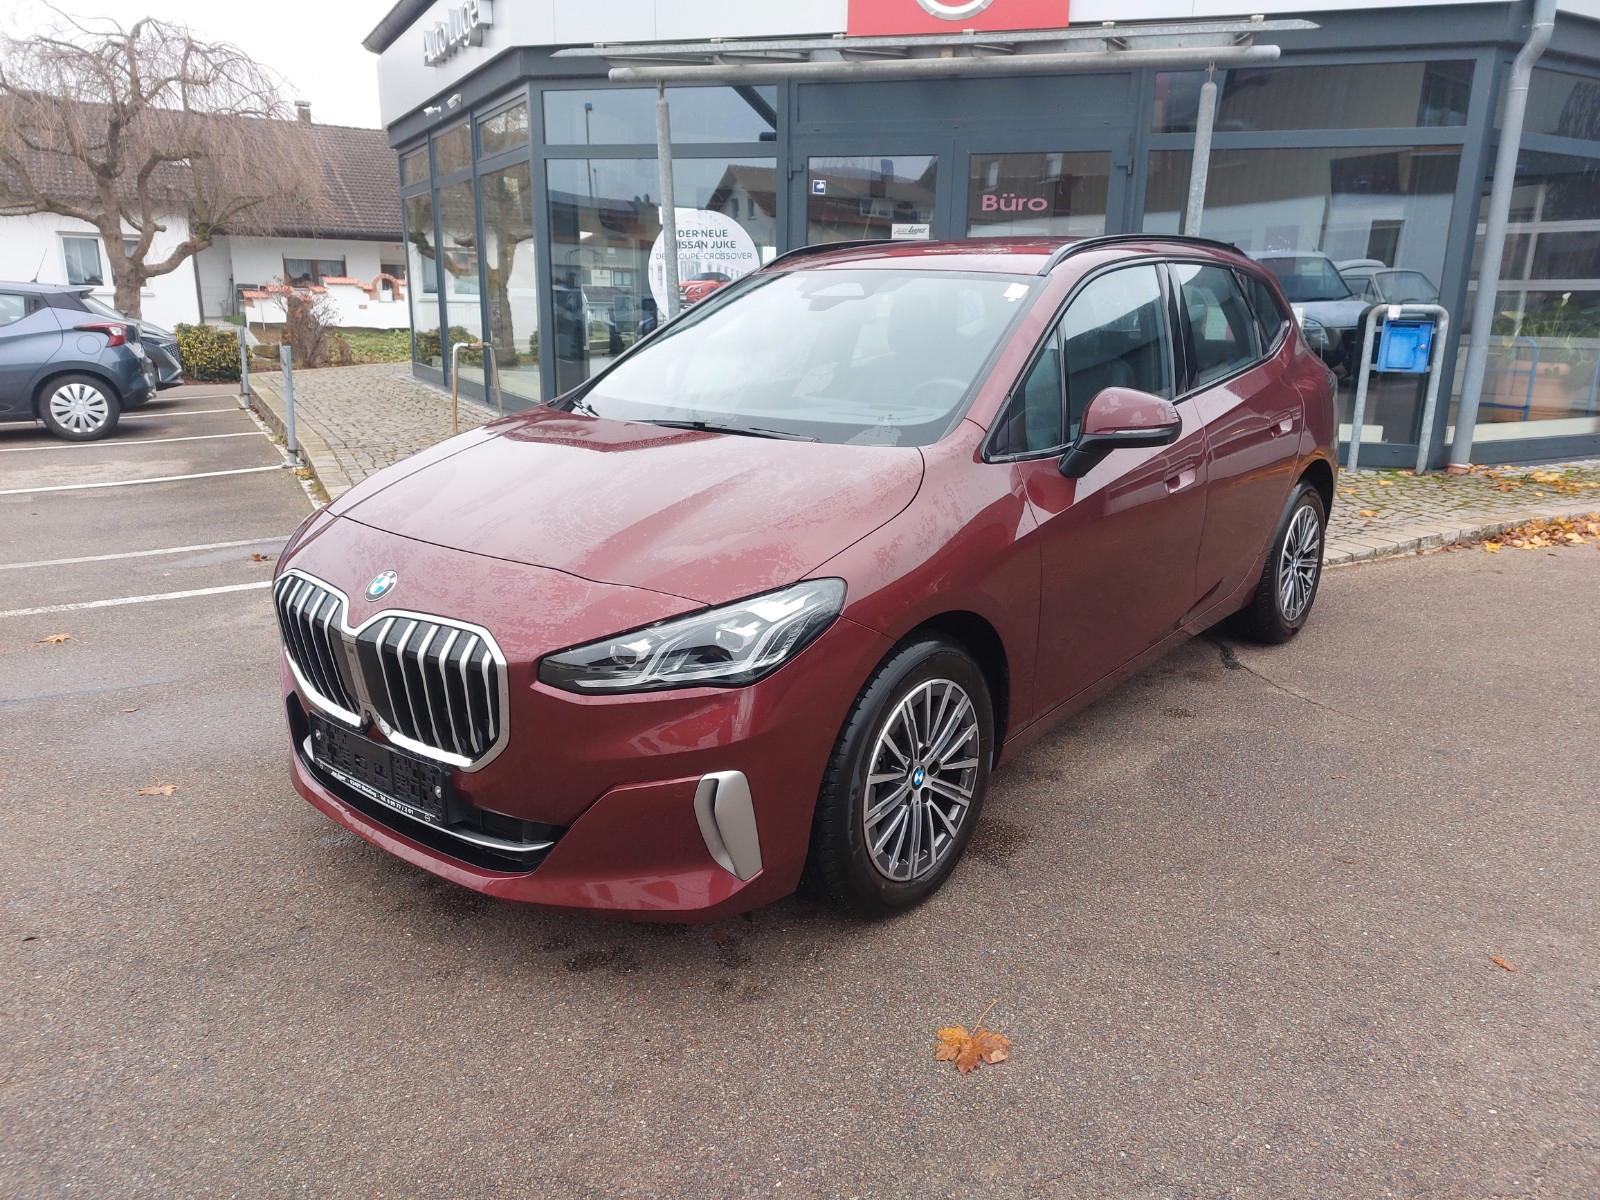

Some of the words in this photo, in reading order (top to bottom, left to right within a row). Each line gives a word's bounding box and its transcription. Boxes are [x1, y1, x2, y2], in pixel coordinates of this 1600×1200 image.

[424, 23, 447, 62] Auto
[982, 193, 1049, 211] Büro
[678, 229, 699, 238] DER
[701, 229, 729, 238] NEUE
[677, 240, 708, 249] ISSAN
[710, 240, 737, 249] JUKE
